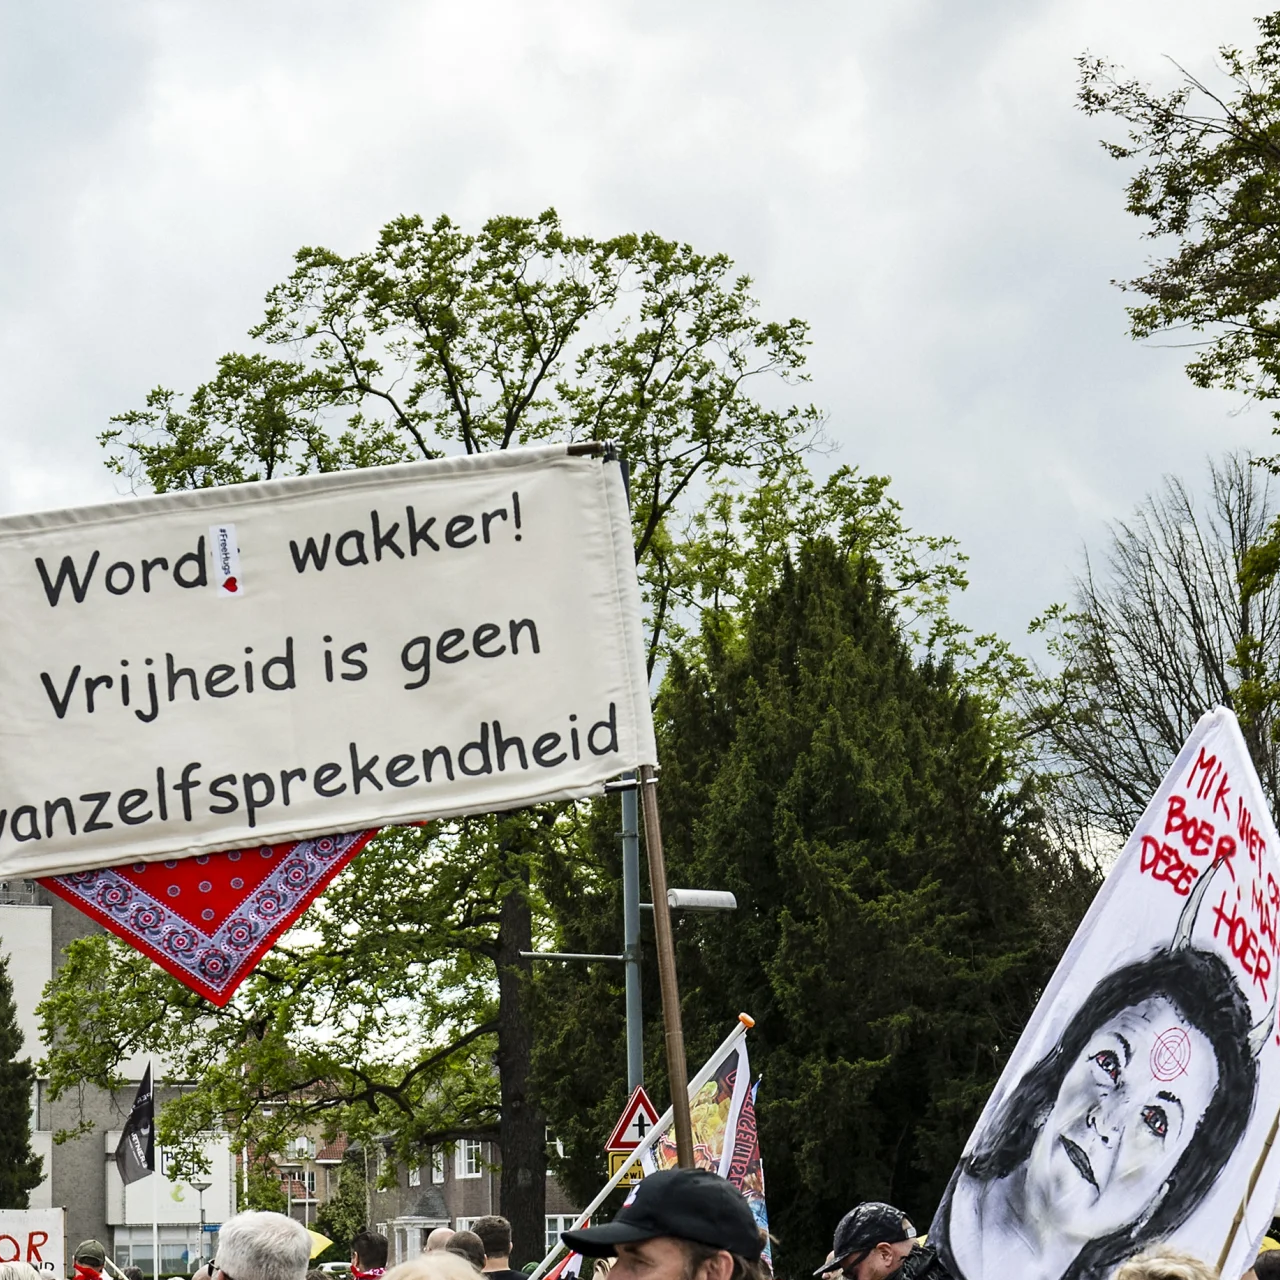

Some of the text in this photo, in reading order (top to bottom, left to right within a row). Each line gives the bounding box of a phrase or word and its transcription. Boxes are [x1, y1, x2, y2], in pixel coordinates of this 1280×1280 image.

[35, 492, 521, 607] Word wakker!
[219, 528, 231, 575] #FreeHugs
[41, 619, 540, 722] Vrijheid is geen
[1187, 746, 1231, 821] MIK
[1140, 835, 1198, 896] DEZE
